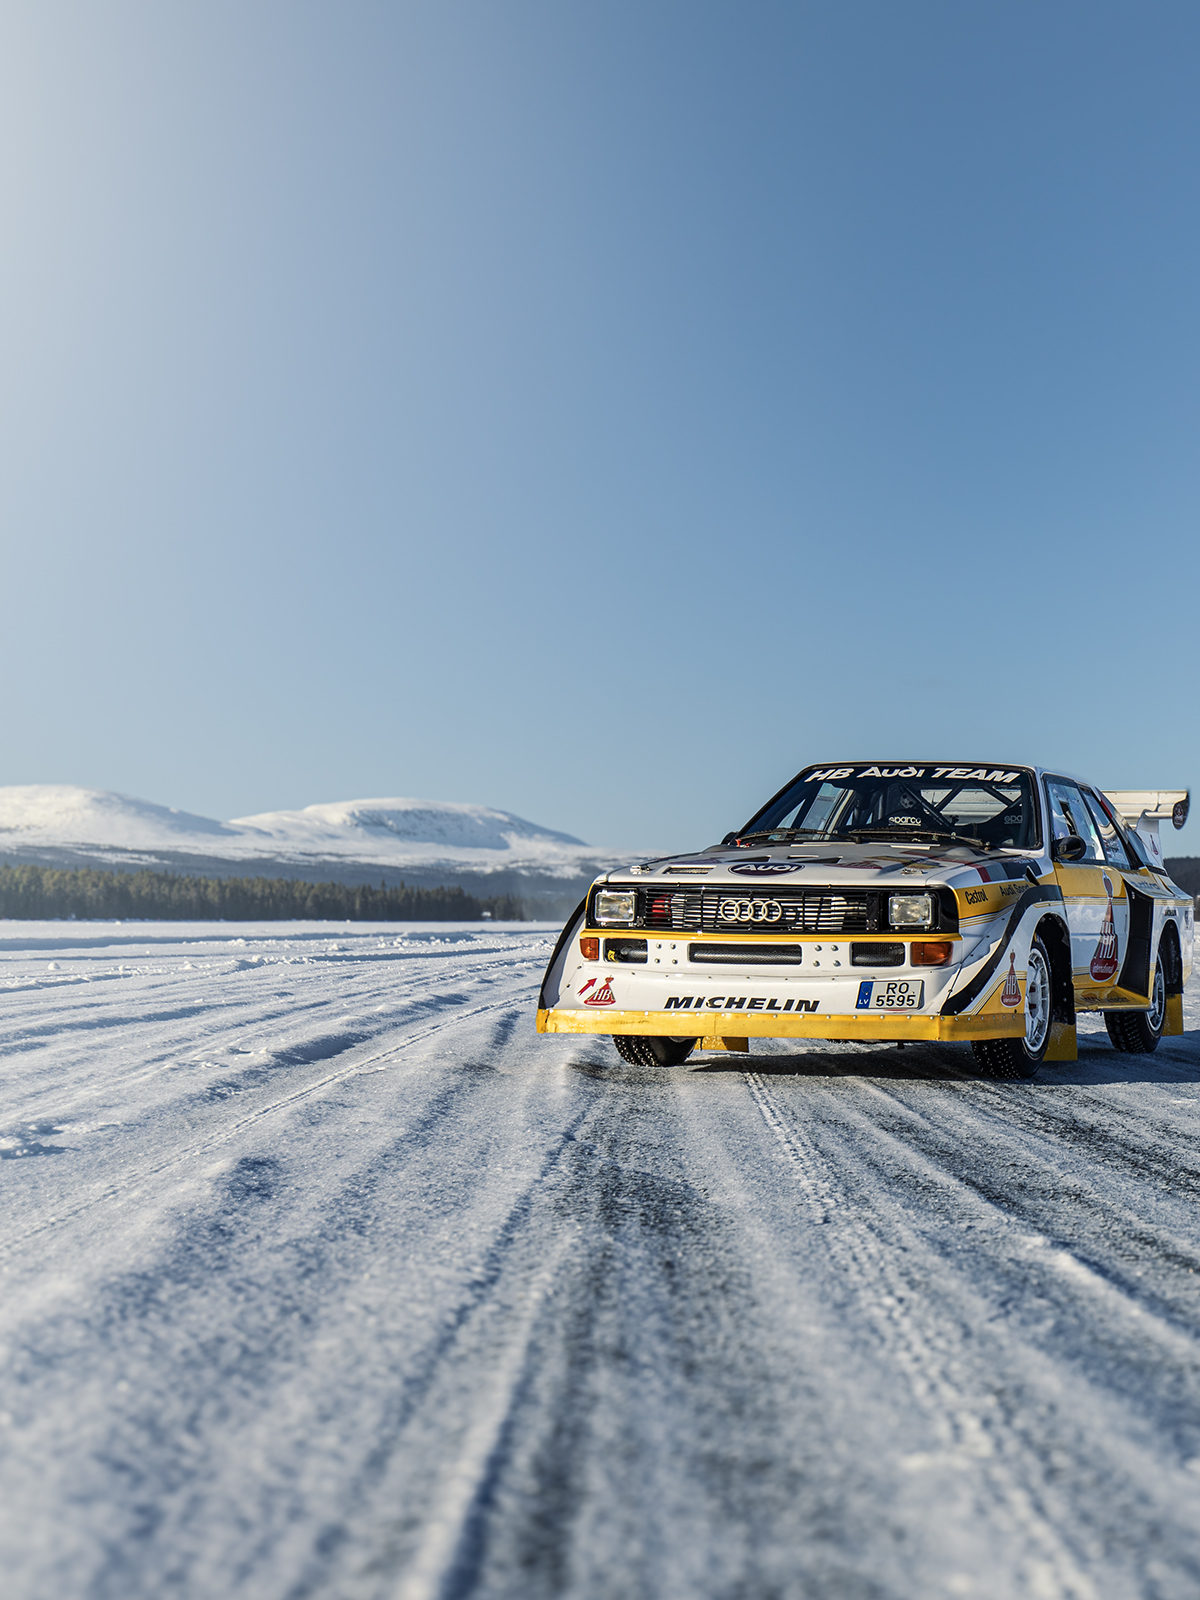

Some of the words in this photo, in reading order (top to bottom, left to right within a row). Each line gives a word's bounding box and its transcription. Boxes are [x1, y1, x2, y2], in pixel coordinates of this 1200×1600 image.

[804, 767, 854, 783] HB
[931, 767, 1021, 783] TEAM
[1004, 815, 1023, 824] spa
[964, 888, 989, 905] Castrol
[999, 884, 1014, 896] Audi
[1100, 920, 1116, 959] HB
[886, 982, 910, 995] RO
[1006, 975, 1017, 995] HB
[593, 989, 612, 1001] HB
[876, 995, 916, 1007] 5595
[664, 996, 820, 1012] MICHELIN
